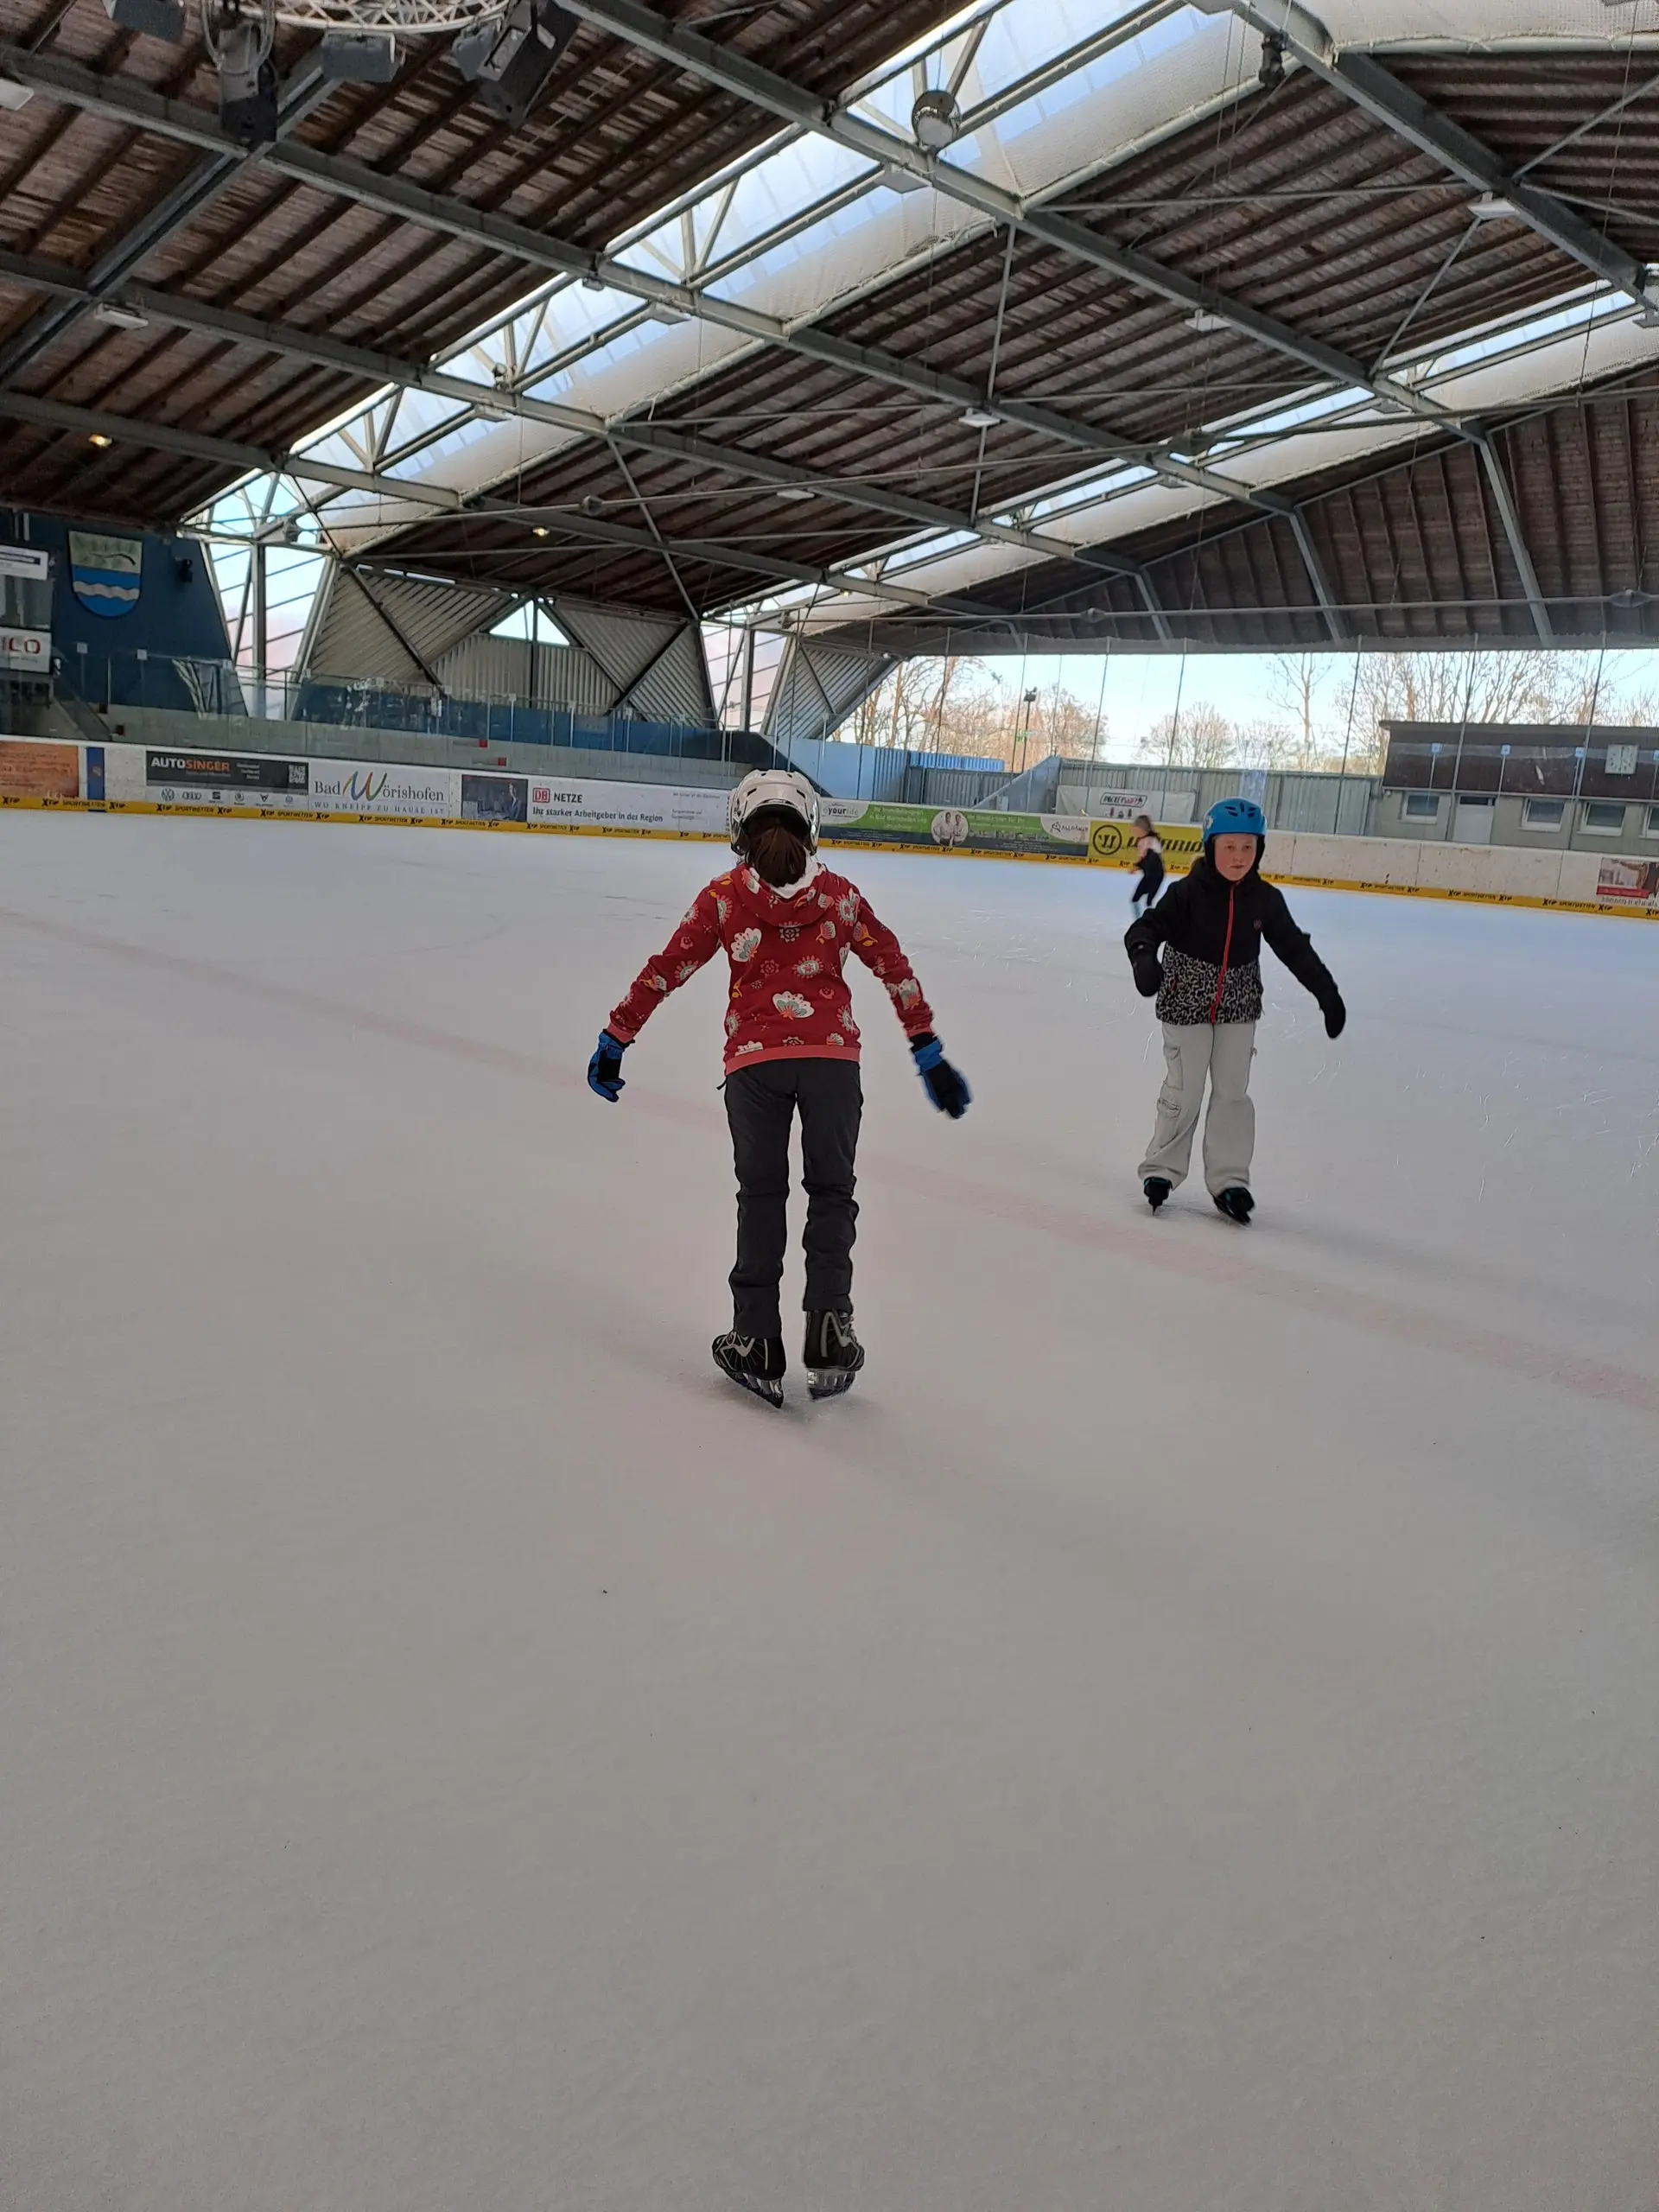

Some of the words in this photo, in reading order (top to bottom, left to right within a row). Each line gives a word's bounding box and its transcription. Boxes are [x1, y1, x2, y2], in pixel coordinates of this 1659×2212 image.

[150, 757, 231, 772] AUTOSINGER
[315, 781, 340, 794] Bad
[342, 771, 446, 802] Wörishofen
[534, 789, 549, 802] DB
[553, 793, 583, 804] NETZE
[533, 807, 543, 816] Ihr
[575, 810, 616, 820] Arbeitgeber
[619, 810, 625, 819] in
[640, 813, 663, 823] Region
